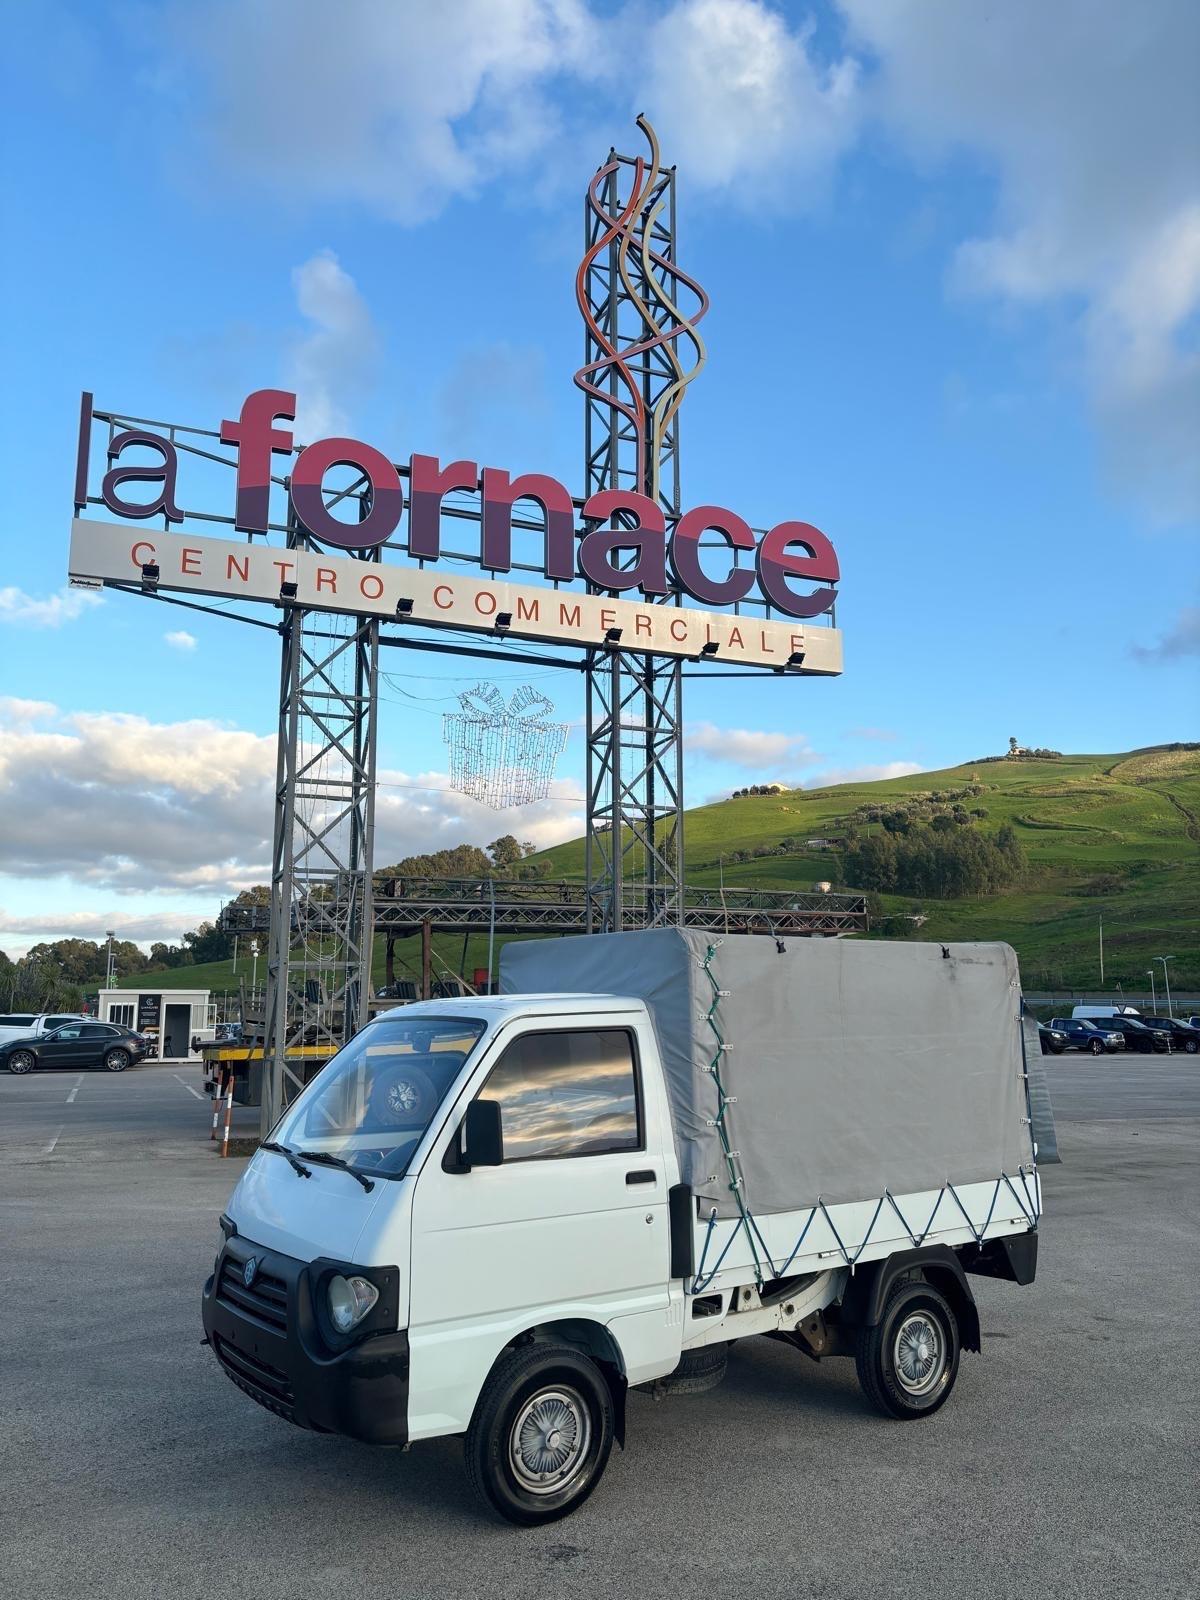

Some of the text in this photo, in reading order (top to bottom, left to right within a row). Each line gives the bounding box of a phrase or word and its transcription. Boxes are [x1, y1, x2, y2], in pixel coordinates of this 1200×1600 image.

[74, 388, 841, 618] la fornace
[131, 541, 805, 656] CENTRO COMMERCIALE
